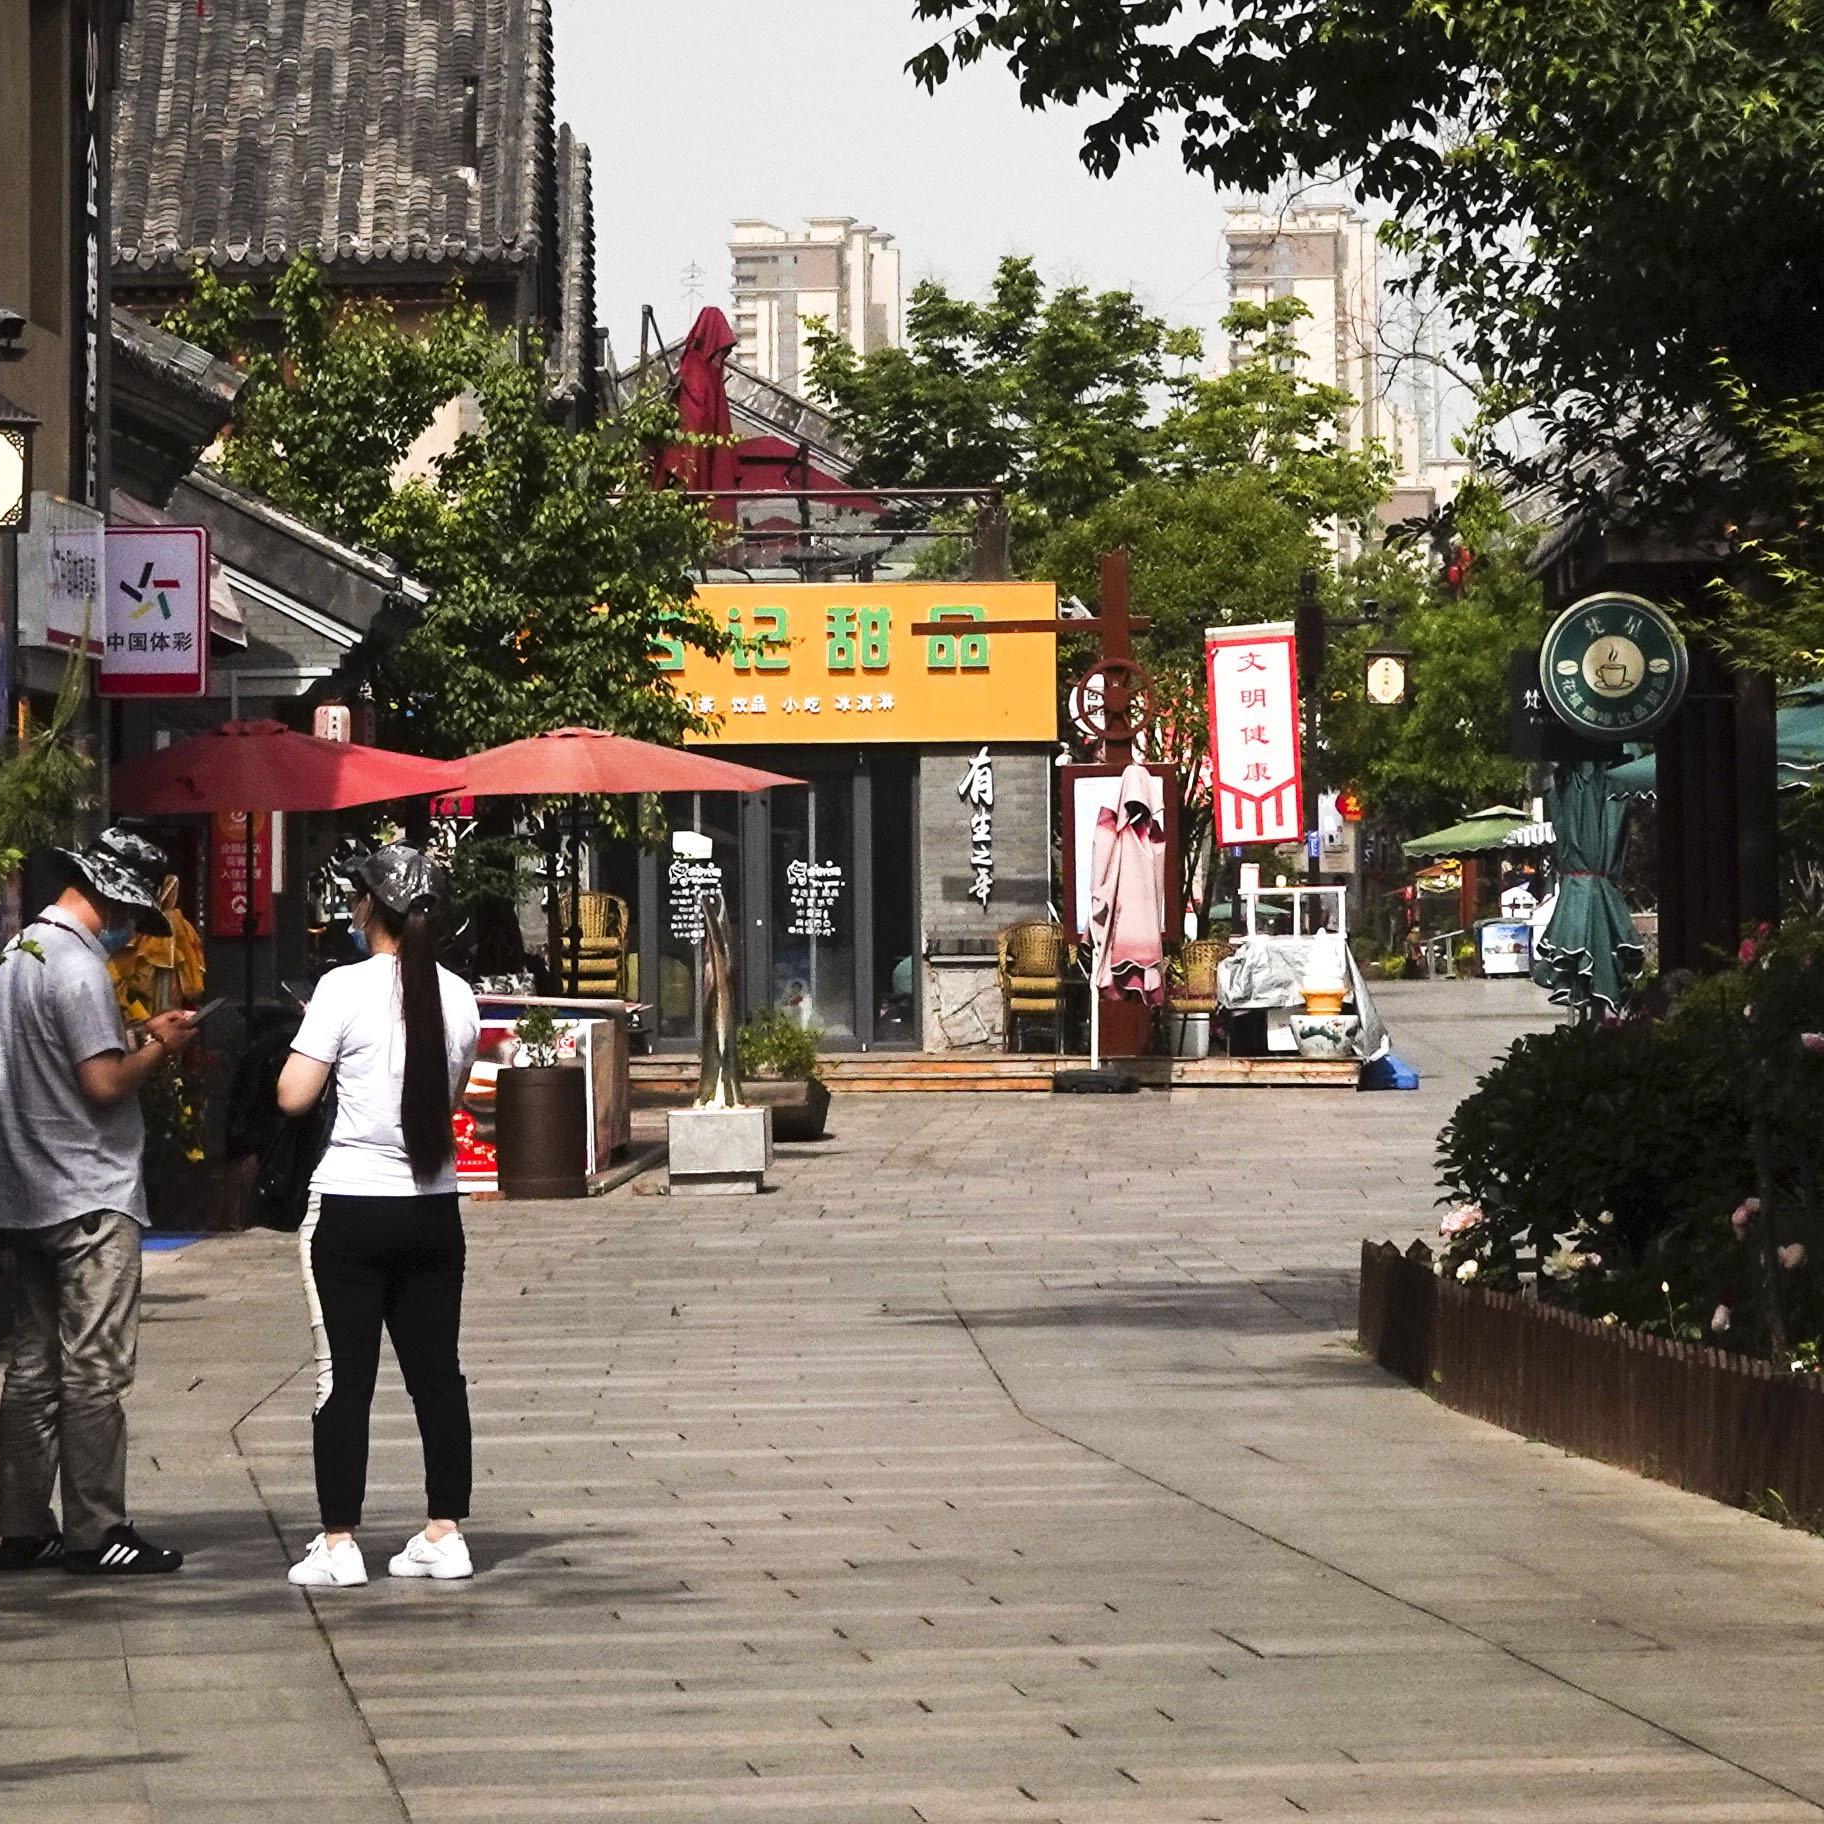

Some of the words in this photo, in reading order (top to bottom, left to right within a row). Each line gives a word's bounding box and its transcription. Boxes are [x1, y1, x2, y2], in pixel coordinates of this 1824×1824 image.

[107, 632, 194, 652] 中国体彩
[733, 696, 766, 713] 饮品
[782, 696, 821, 713] 小吃
[834, 694, 896, 713] 冰淇淋
[1236, 651, 1273, 783] 文明健康
[957, 745, 994, 907] 有生之年
